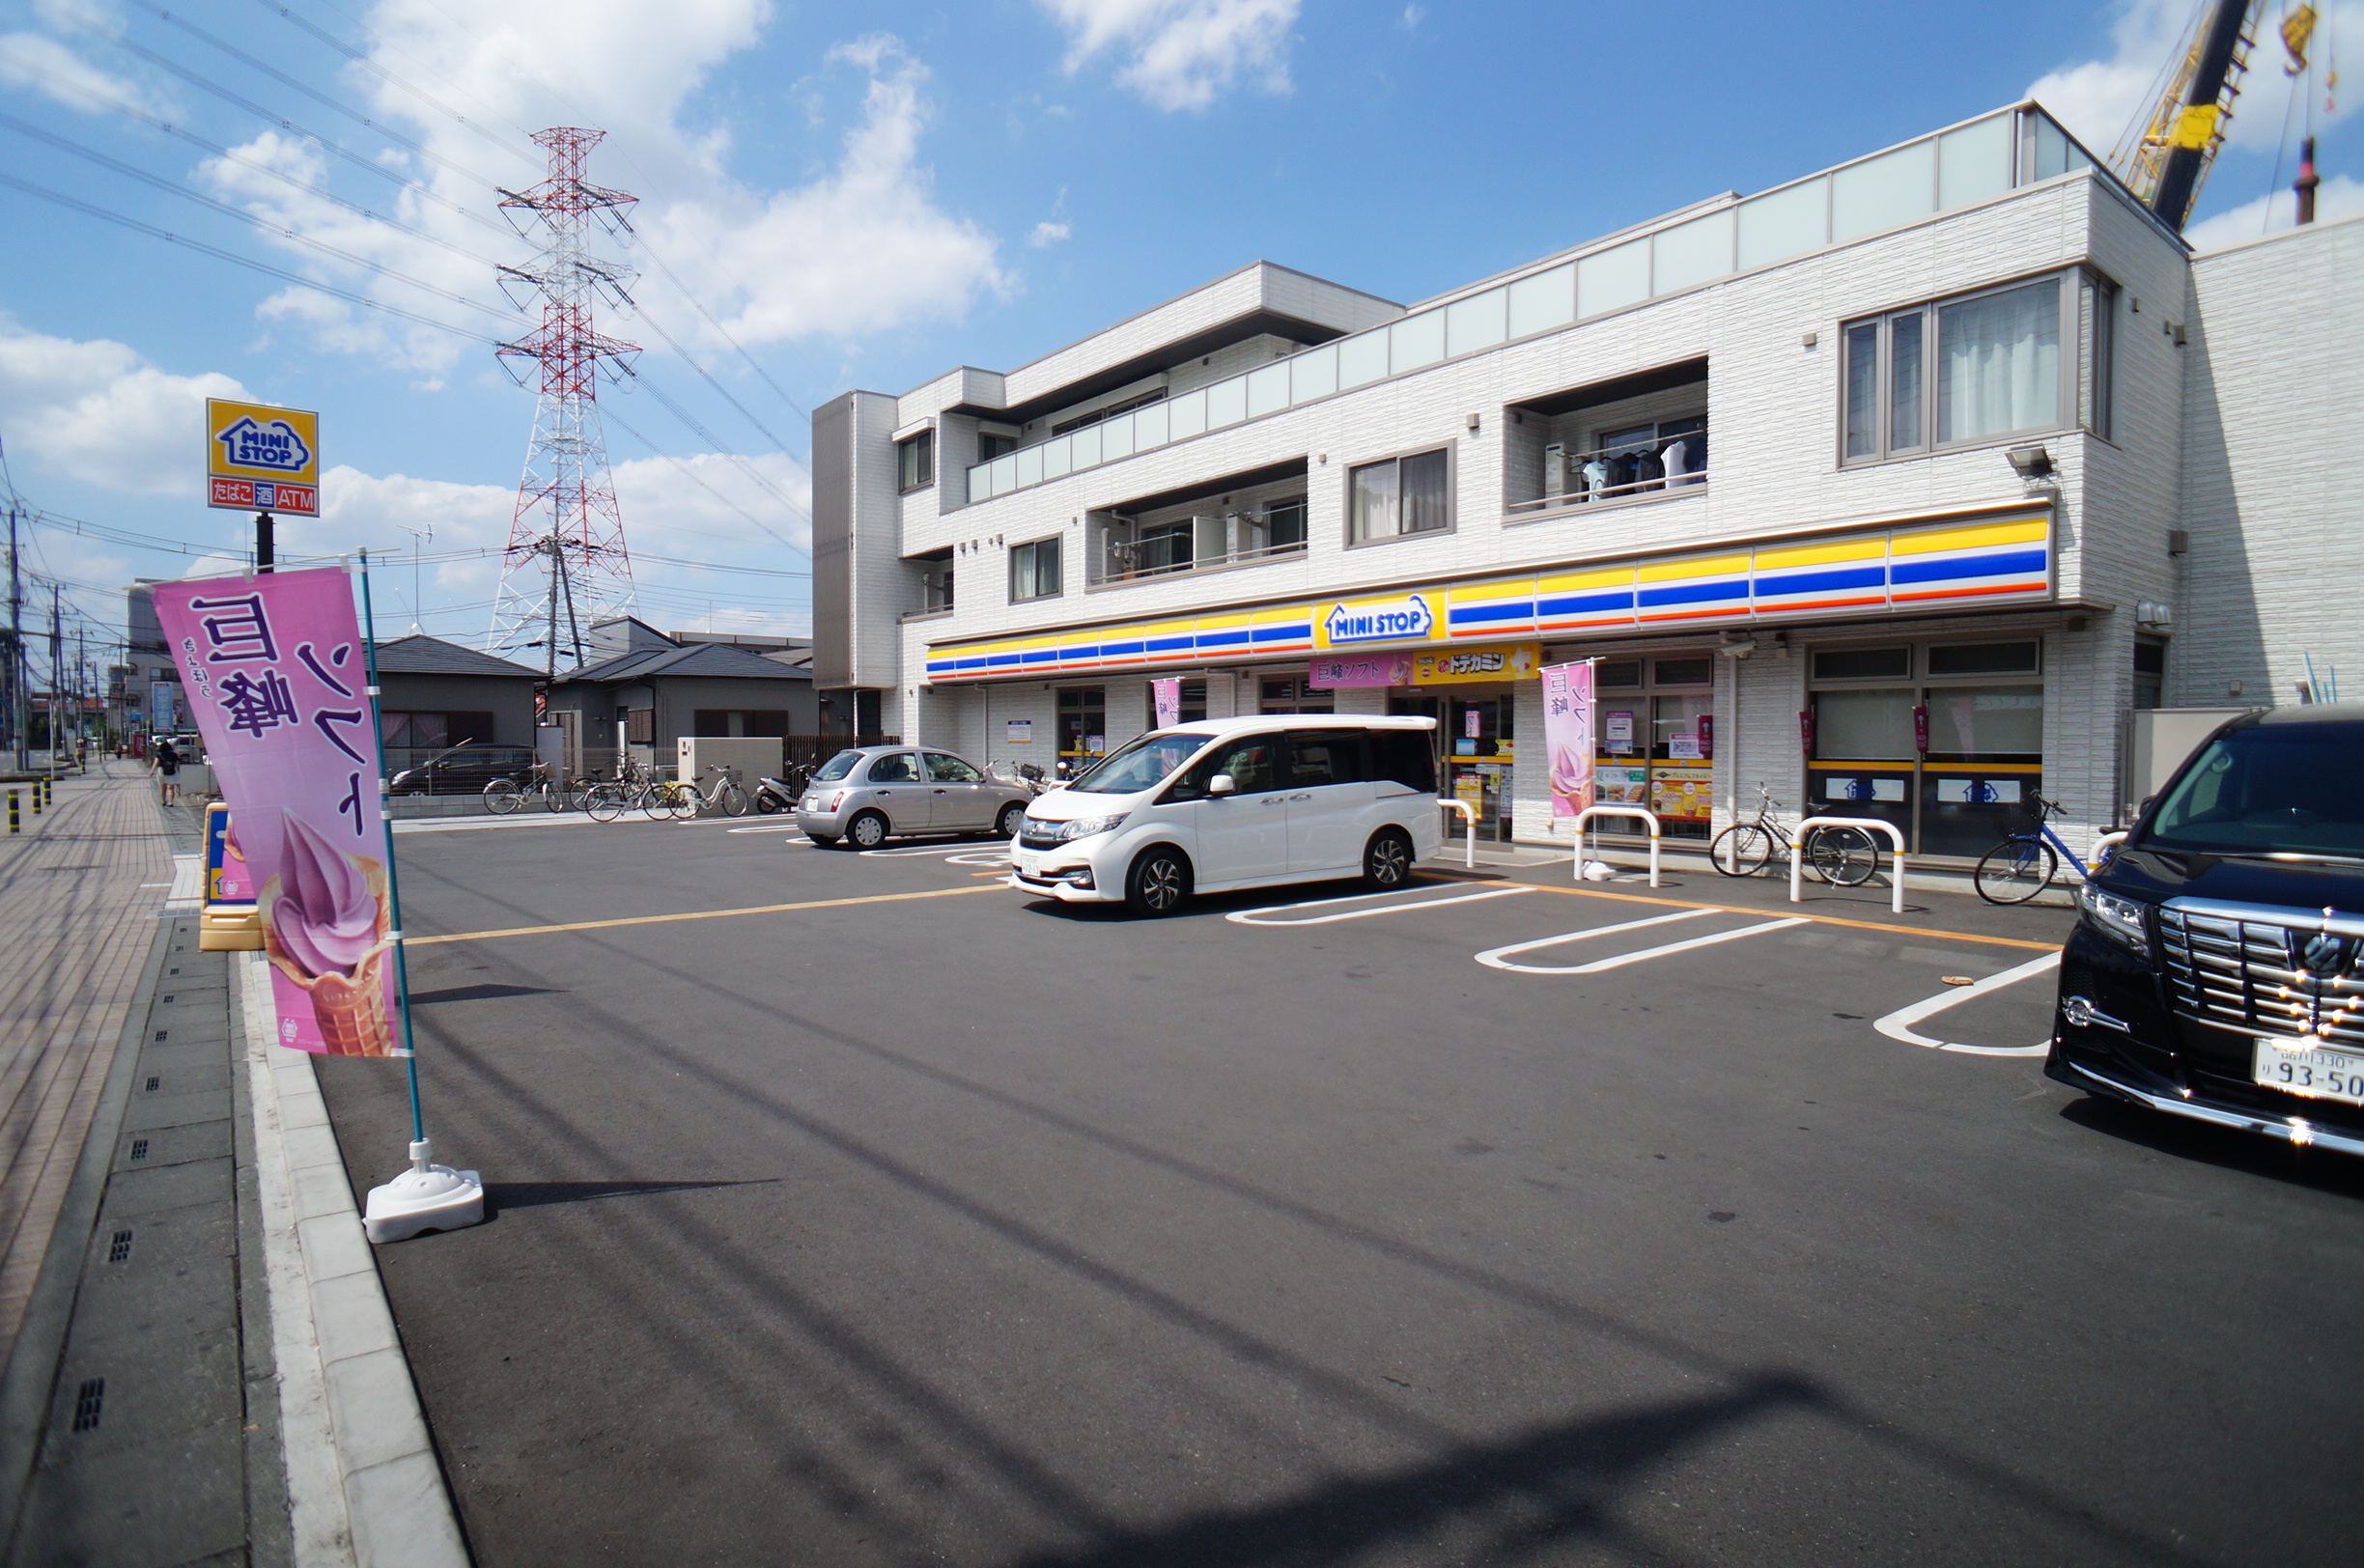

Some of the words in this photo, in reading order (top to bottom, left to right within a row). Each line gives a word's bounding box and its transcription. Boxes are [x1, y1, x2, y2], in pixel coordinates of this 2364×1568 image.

[241, 430, 290, 449] MINI
[239, 445, 292, 463] STOP
[213, 483, 252, 501] たばこ
[256, 486, 273, 504] 酒
[277, 489, 314, 509] ATM
[1335, 615, 1372, 637] MINI
[1375, 610, 1421, 633] STOP
[1317, 661, 1379, 682] 巨峰ソフト
[1449, 653, 1505, 674] ドデカミン
[2278, 1062, 2364, 1097] 93-50
